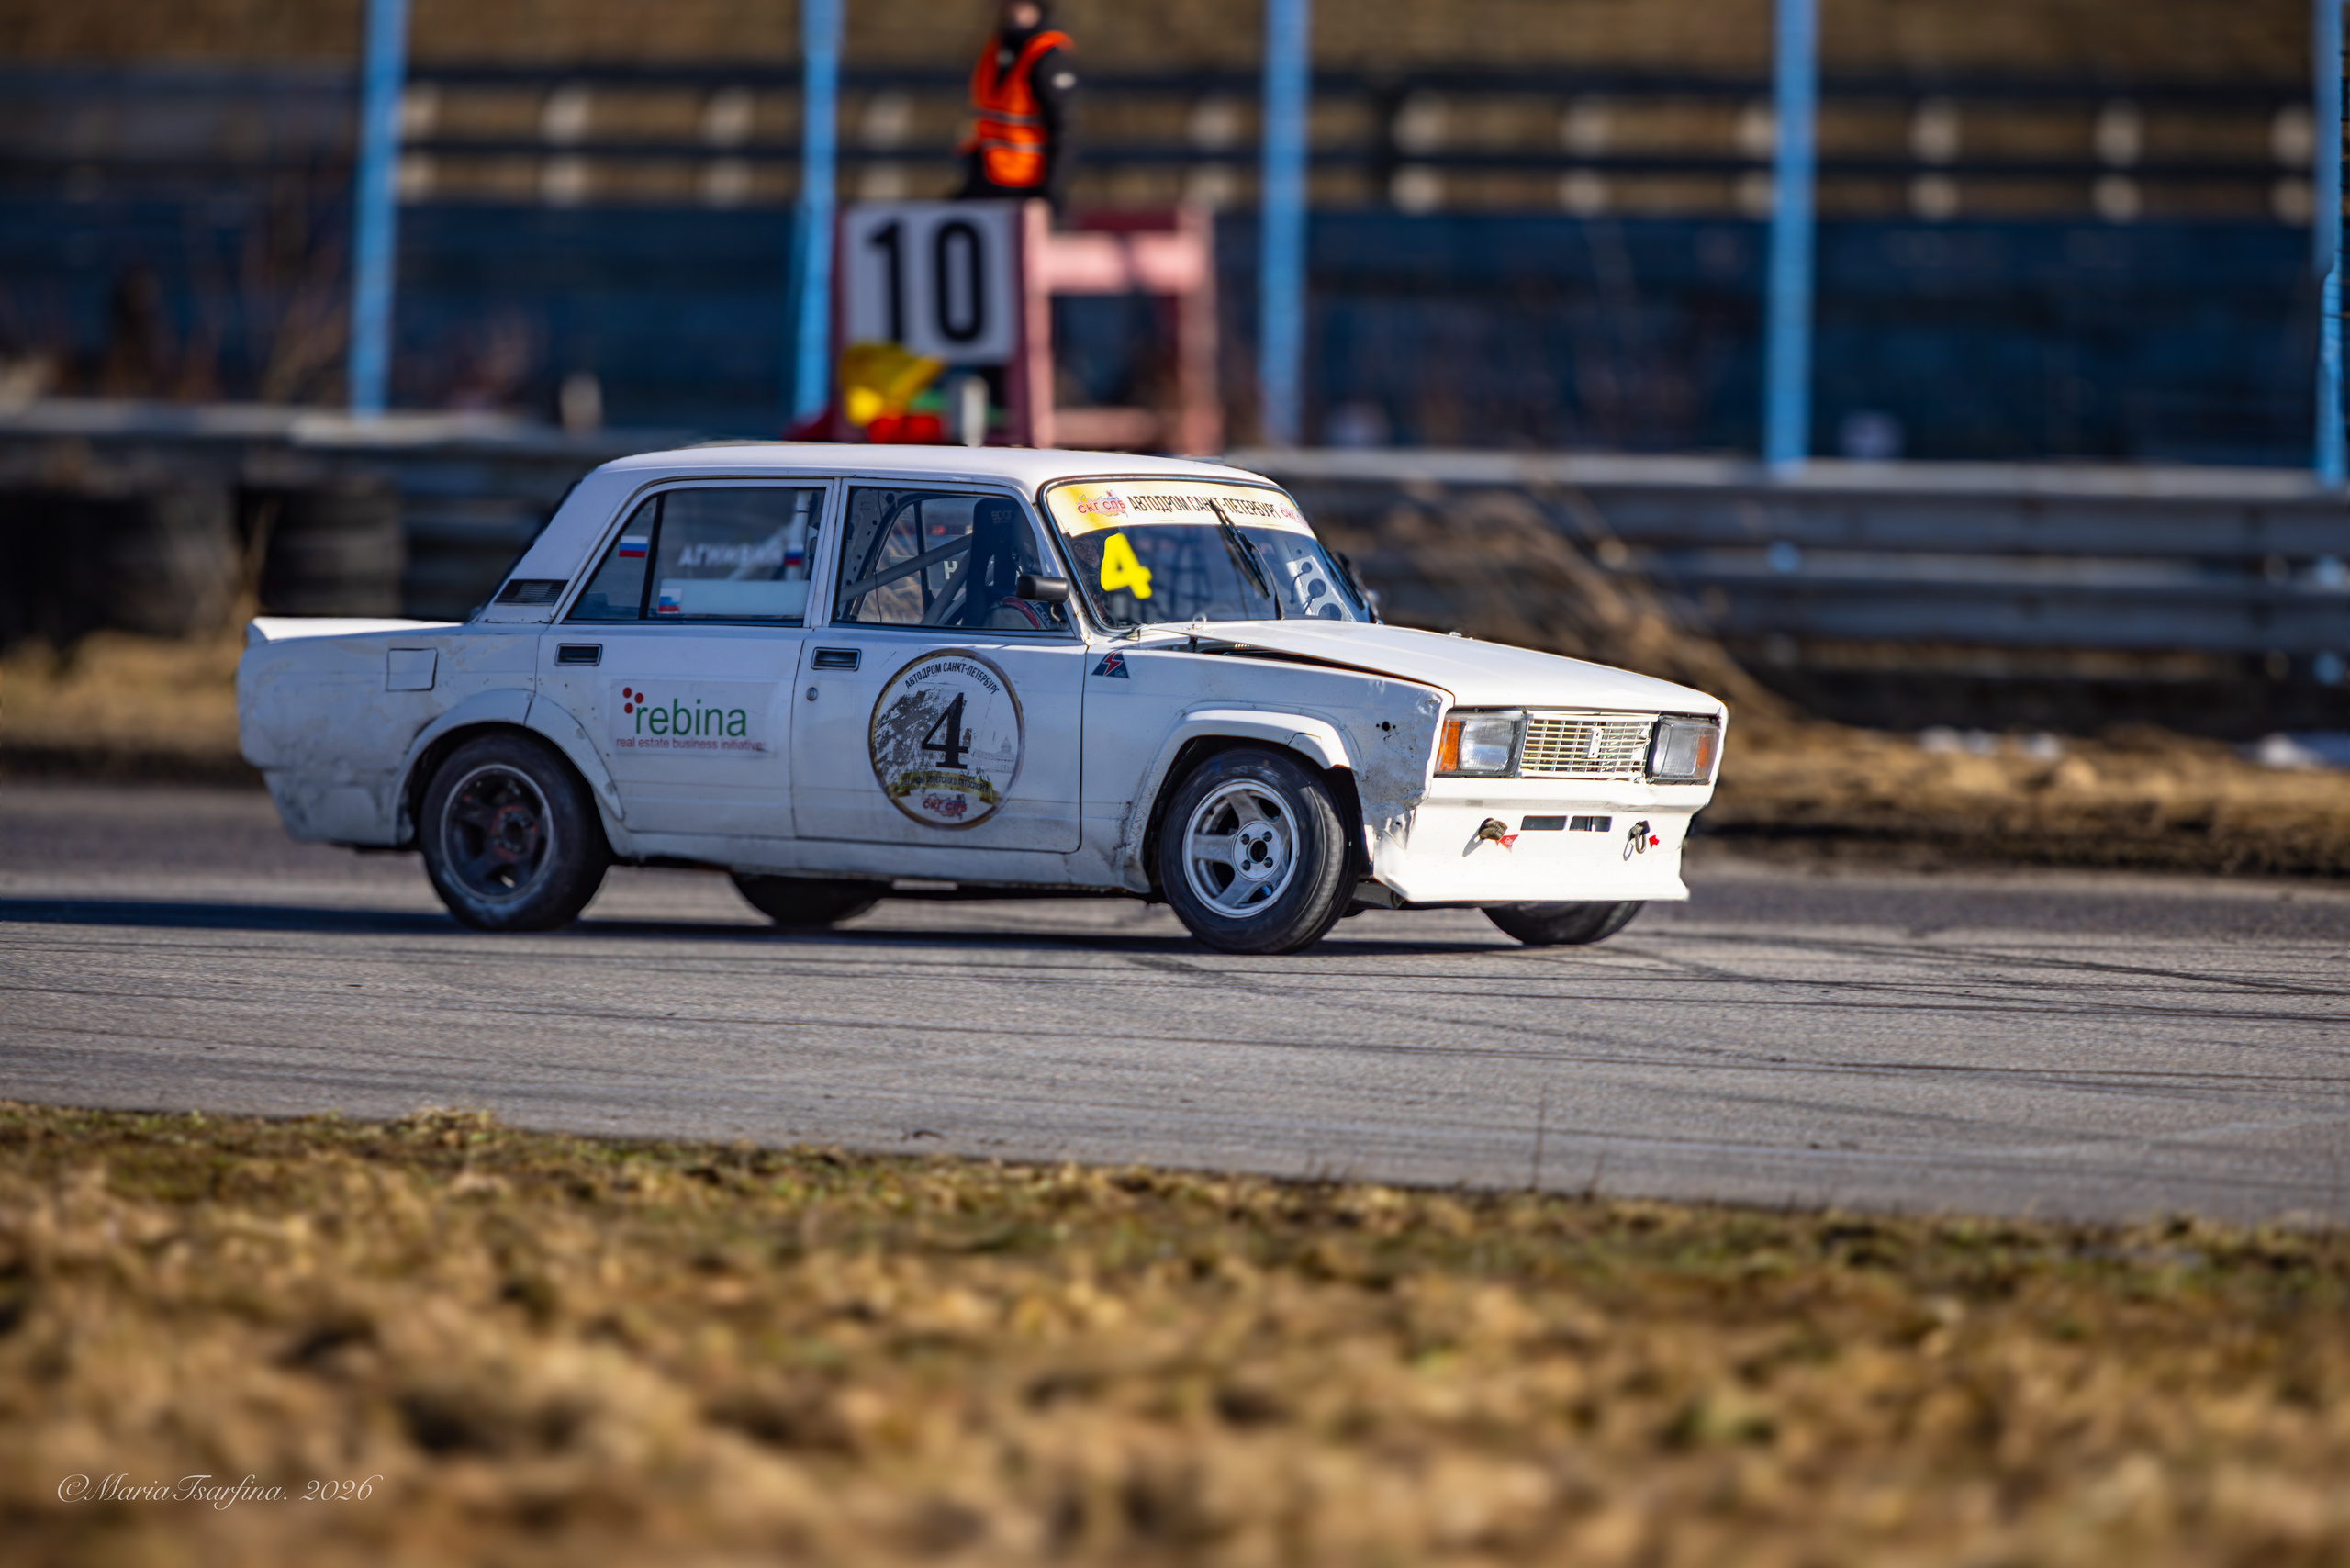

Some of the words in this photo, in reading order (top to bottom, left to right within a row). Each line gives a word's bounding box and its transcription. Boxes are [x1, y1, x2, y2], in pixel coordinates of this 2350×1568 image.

[865, 218, 985, 344] 10
[1126, 496, 1192, 512] АВТОДРОМ
[1100, 532, 1152, 599] 4
[904, 662, 941, 689] АВТОДРОМ
[943, 662, 1000, 695] САНКТ-ПЕТЕРБУРГ
[636, 698, 746, 737] rebina
[922, 692, 968, 769] 4
[616, 737, 635, 748] real
[638, 738, 669, 749] estate
[673, 738, 718, 750] business
